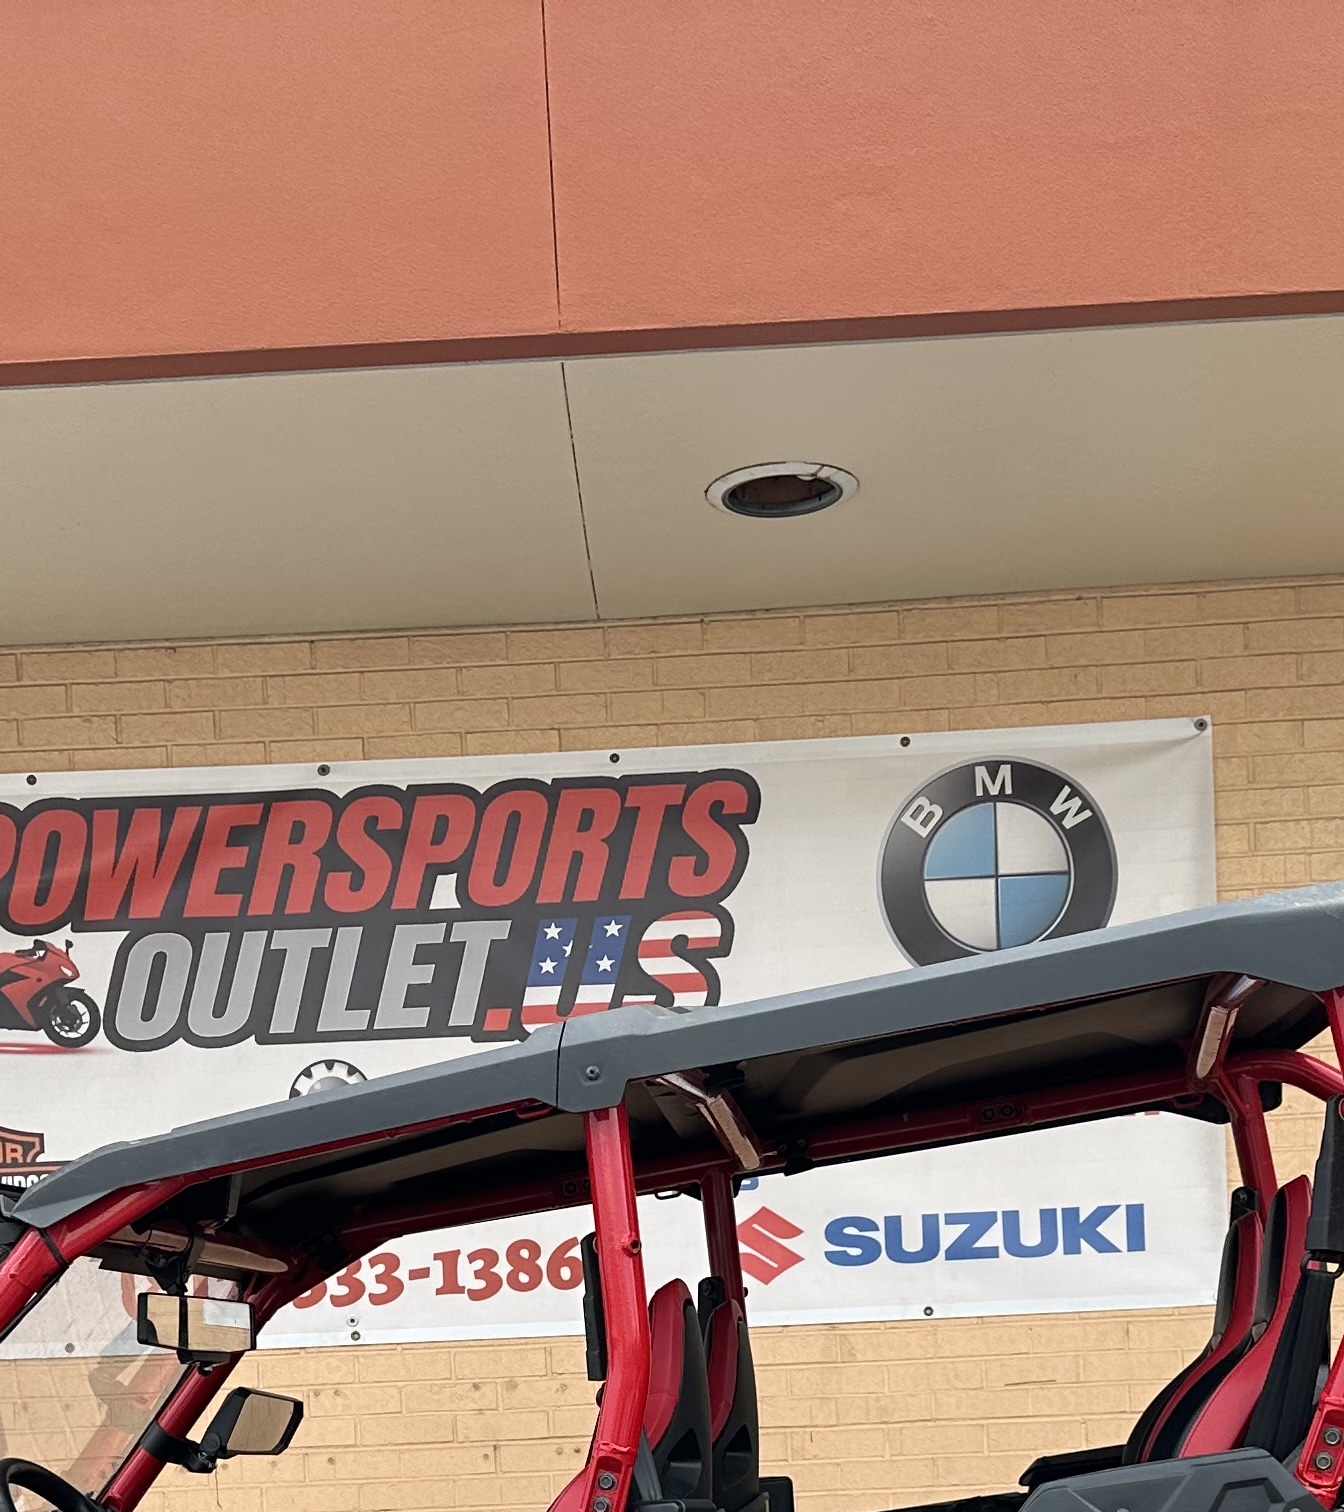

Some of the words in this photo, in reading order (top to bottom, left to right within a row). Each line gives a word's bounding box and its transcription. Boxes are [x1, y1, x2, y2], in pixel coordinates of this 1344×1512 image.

[900, 763, 1092, 840] BMW
[119, 909, 723, 1039] OUTLET.US
[823, 1202, 1147, 1268] SUZUKI
